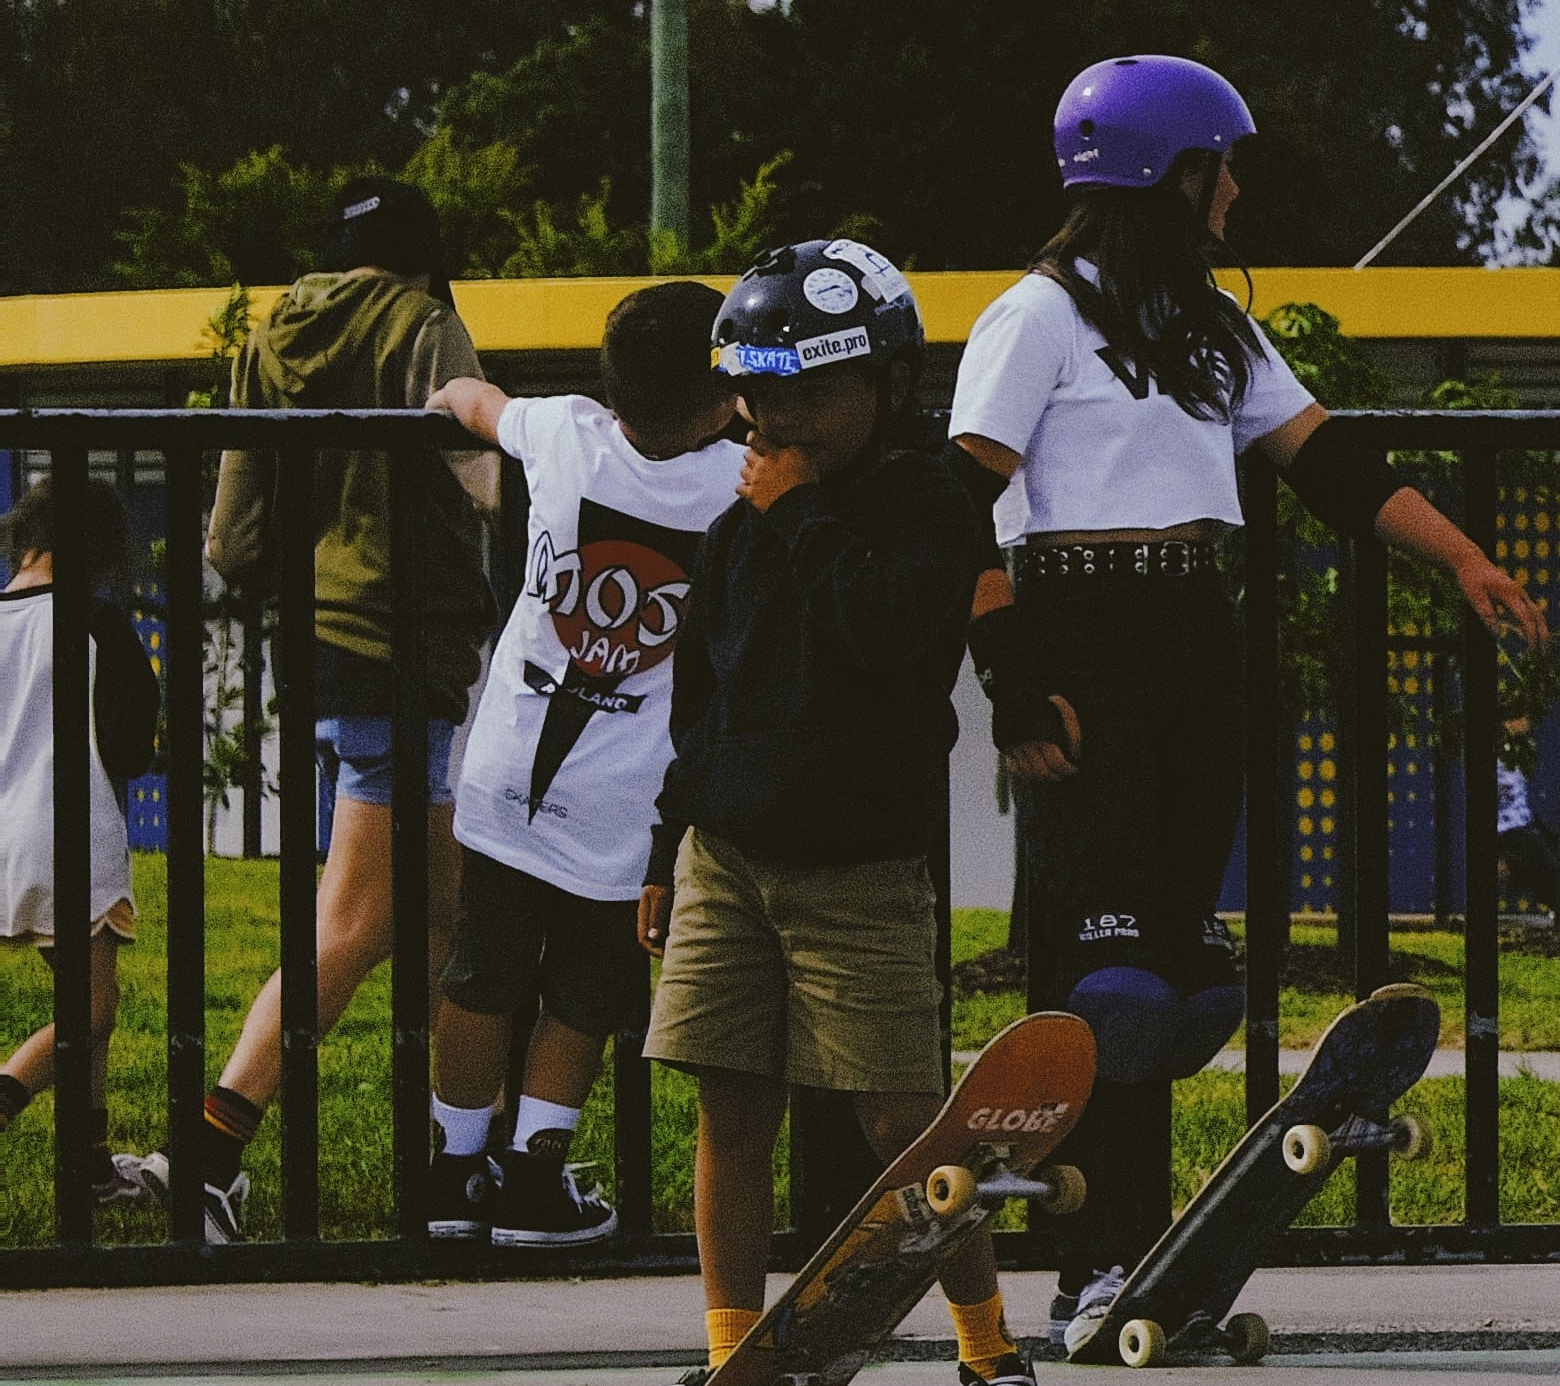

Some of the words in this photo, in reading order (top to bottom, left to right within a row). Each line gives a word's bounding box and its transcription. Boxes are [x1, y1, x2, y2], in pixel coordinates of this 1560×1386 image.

[570, 629, 641, 675] JAM
[1083, 914, 1137, 931] 187
[967, 1105, 1064, 1133] GLOBE
